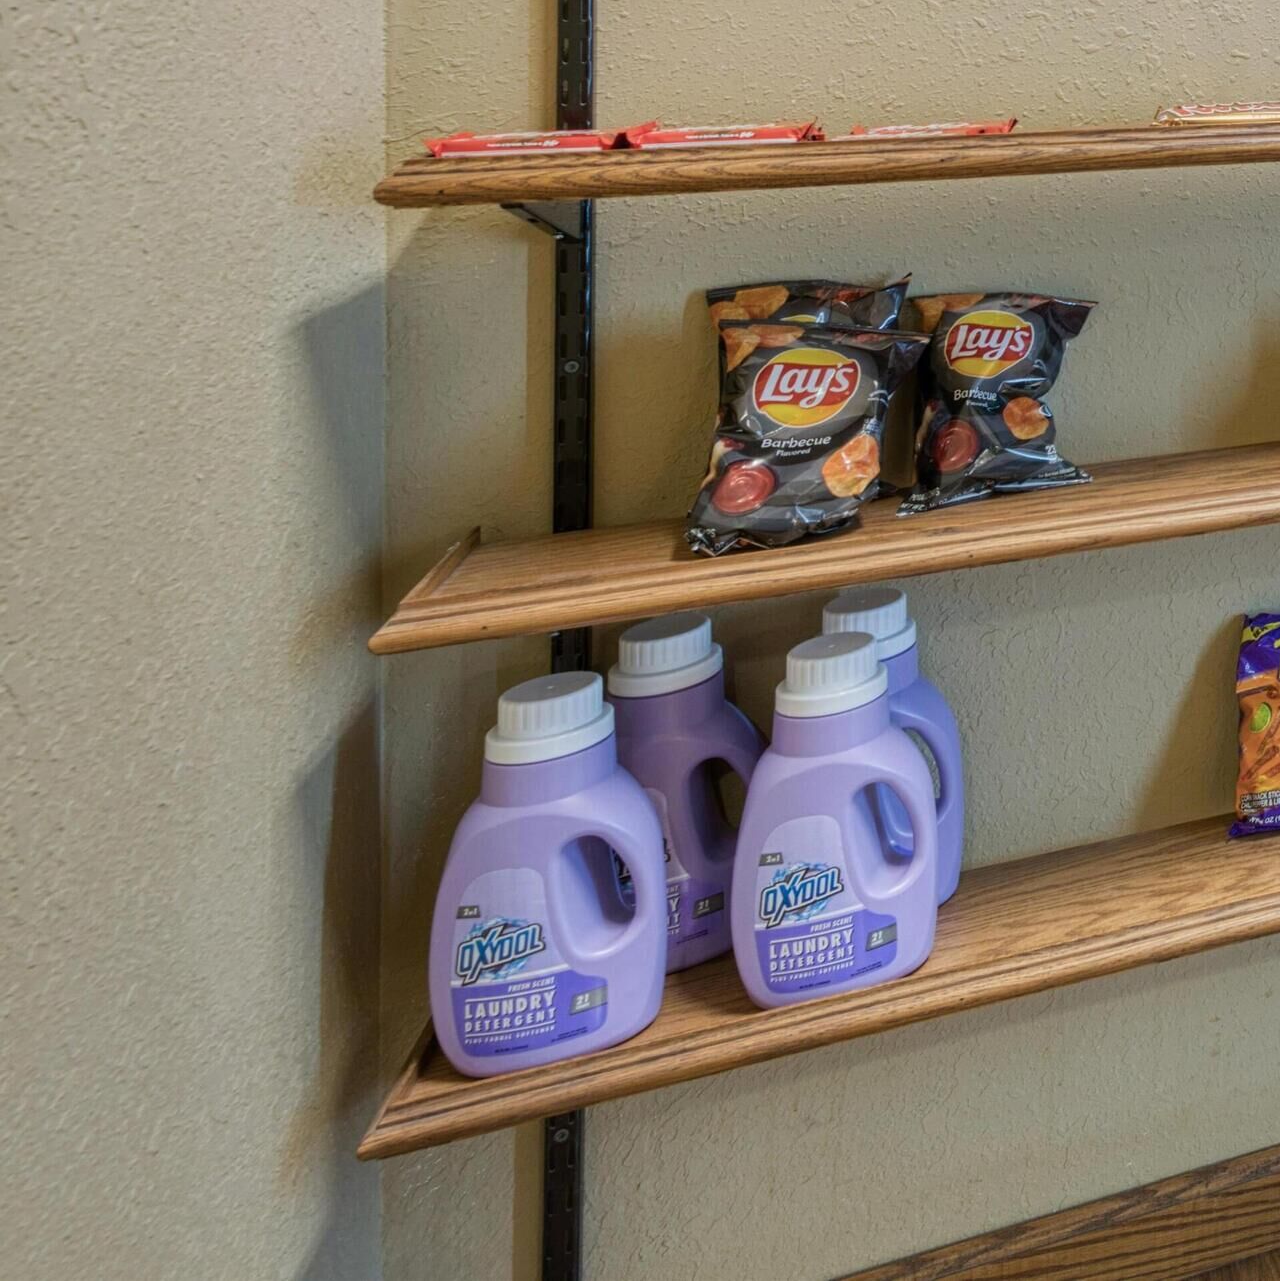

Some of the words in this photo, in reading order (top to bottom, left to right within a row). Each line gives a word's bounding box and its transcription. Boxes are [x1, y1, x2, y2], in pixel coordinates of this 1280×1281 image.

[951, 324, 1029, 361] Lay's
[759, 362, 856, 409] Lay's
[953, 388, 997, 403] Barbecue
[760, 435, 832, 449] Barbecue
[775, 447, 811, 457] Flavored
[760, 867, 844, 929] OXYDOL
[810, 923, 831, 932] FRESH
[832, 916, 852, 927] SCENT
[871, 931, 882, 941] 21
[457, 924, 545, 986] OXYDOL
[770, 928, 854, 959] LAUNDRY
[770, 945, 854, 972] DETERGENT
[508, 982, 530, 993] FRESH
[531, 976, 555, 989] SCENT
[465, 990, 557, 1020] LAUNDRY
[576, 993, 589, 1005] 21
[465, 1007, 557, 1033] DETERGENT
